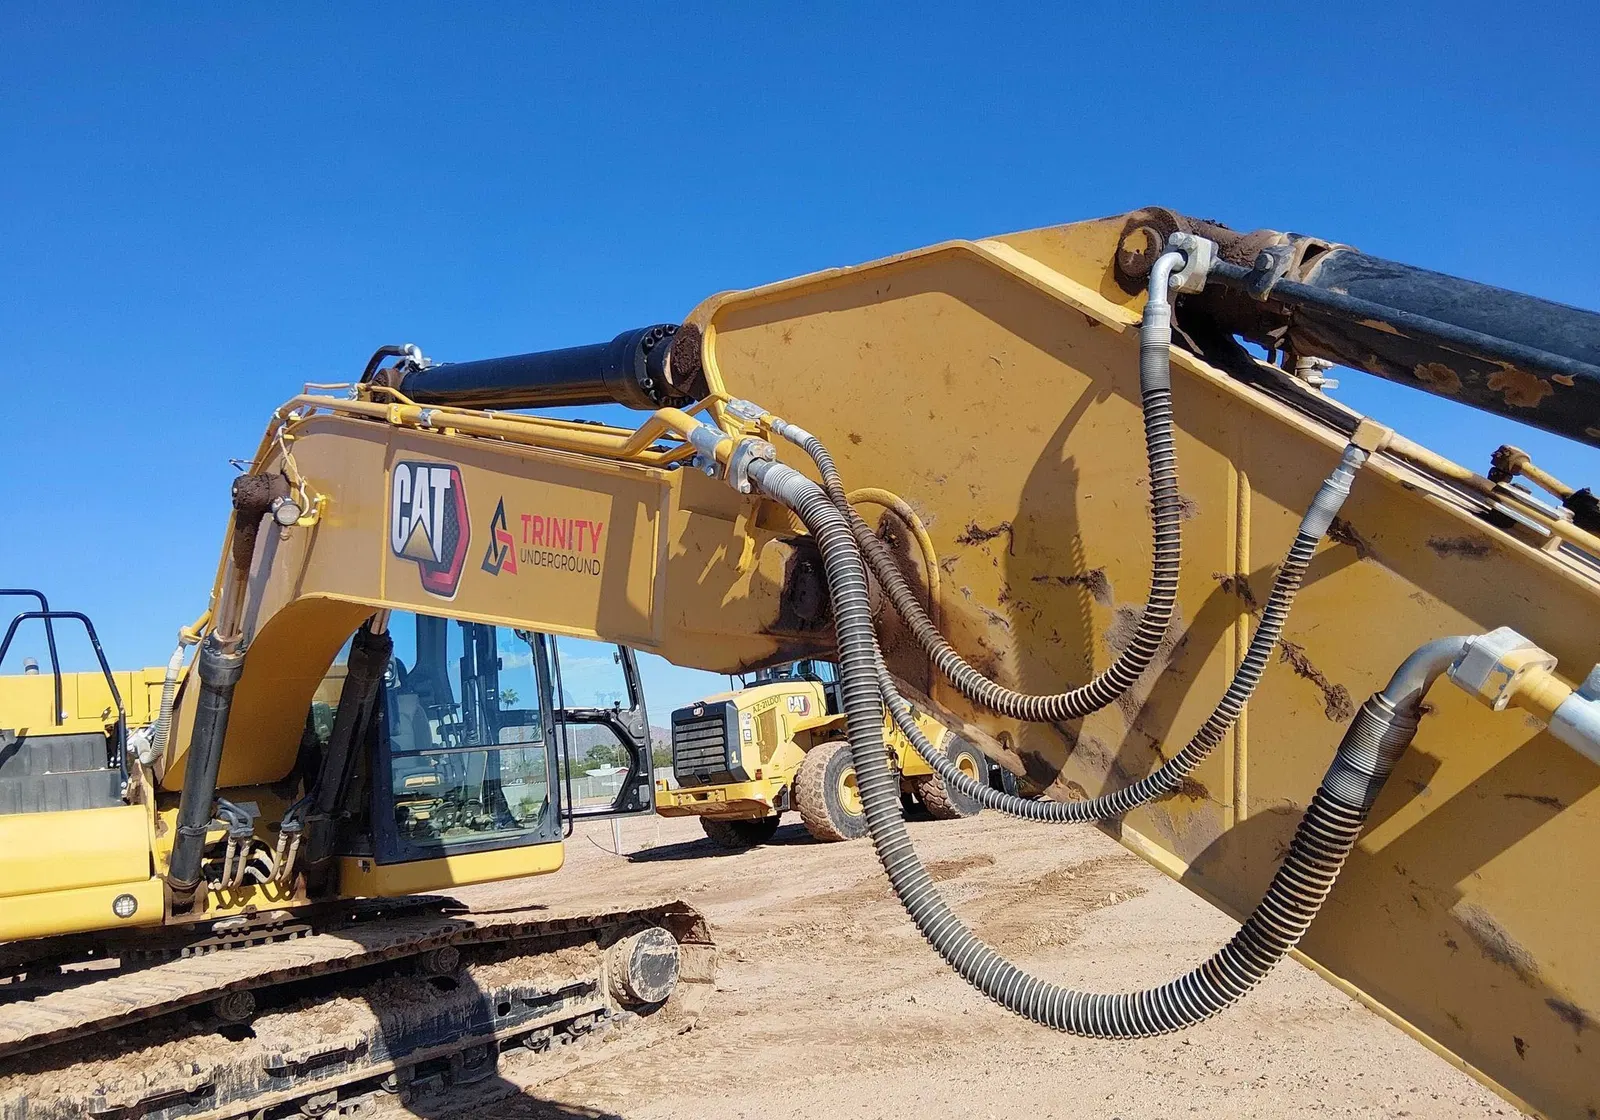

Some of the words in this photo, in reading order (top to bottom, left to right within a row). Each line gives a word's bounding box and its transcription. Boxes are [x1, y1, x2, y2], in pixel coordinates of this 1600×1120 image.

[392, 463, 451, 563] CAT
[520, 515, 603, 553] TRINITY
[520, 548, 601, 576] UNDERGROUND
[788, 696, 805, 713] CAT
[731, 751, 739, 764] 1
